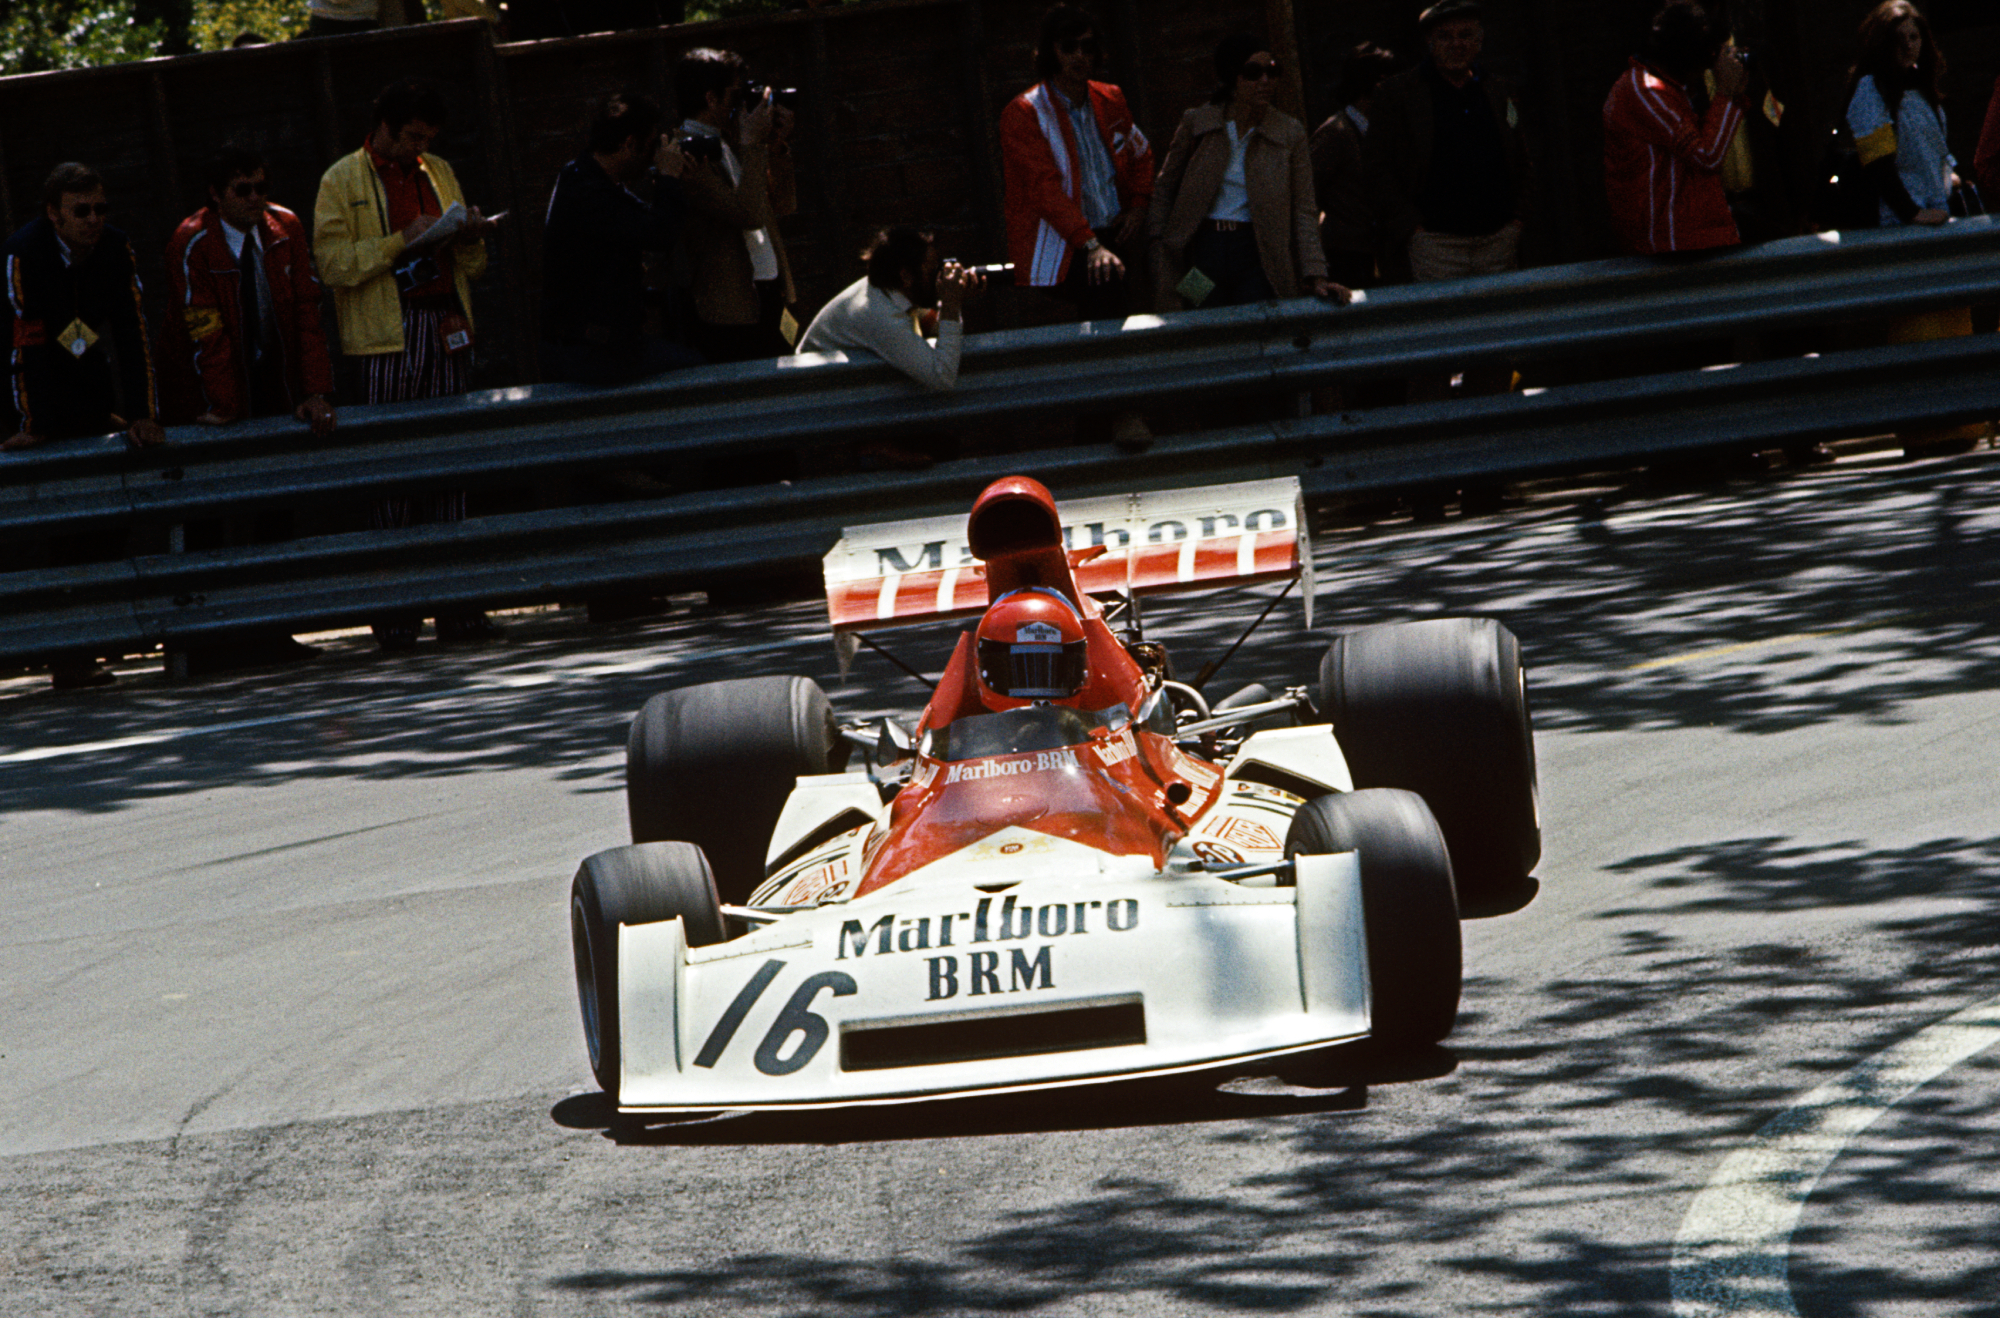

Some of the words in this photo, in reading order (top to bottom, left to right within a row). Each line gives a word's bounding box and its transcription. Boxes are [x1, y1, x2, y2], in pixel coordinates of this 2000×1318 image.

[836, 895, 1139, 960] Marlboro
[924, 945, 1056, 1001] BRM
[693, 959, 858, 1077] 16
